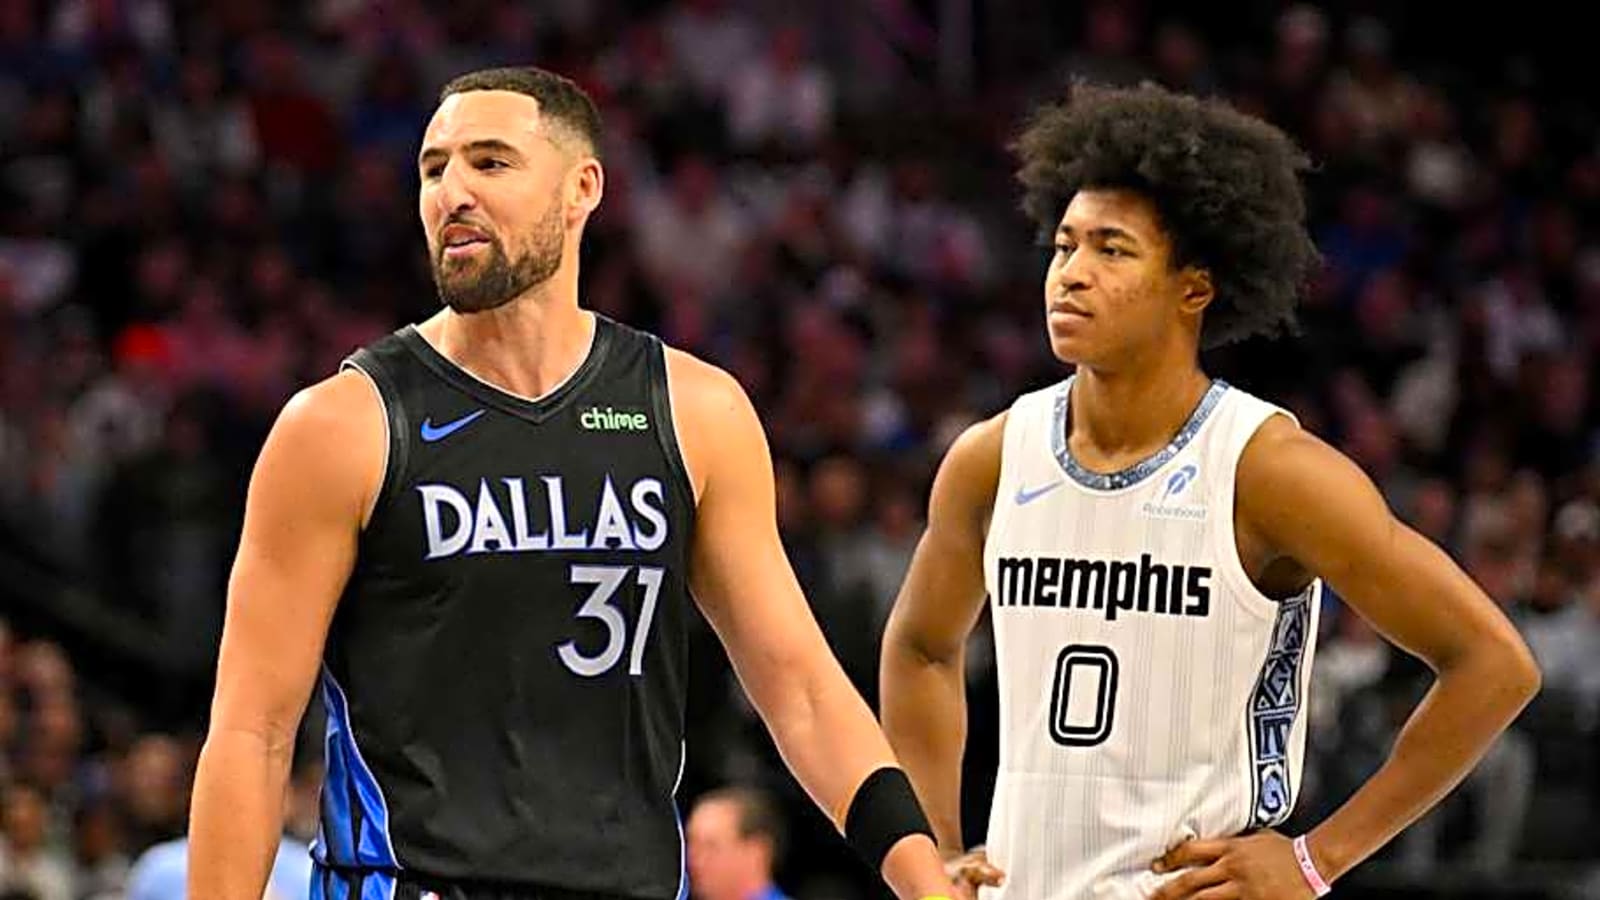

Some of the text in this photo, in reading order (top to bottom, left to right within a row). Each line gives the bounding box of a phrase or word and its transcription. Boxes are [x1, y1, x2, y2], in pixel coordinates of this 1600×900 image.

[580, 407, 648, 431] chime
[416, 473, 668, 560] DALLAS
[556, 565, 665, 677] 31
[998, 554, 1212, 620] memphis
[1048, 644, 1119, 748] 0
